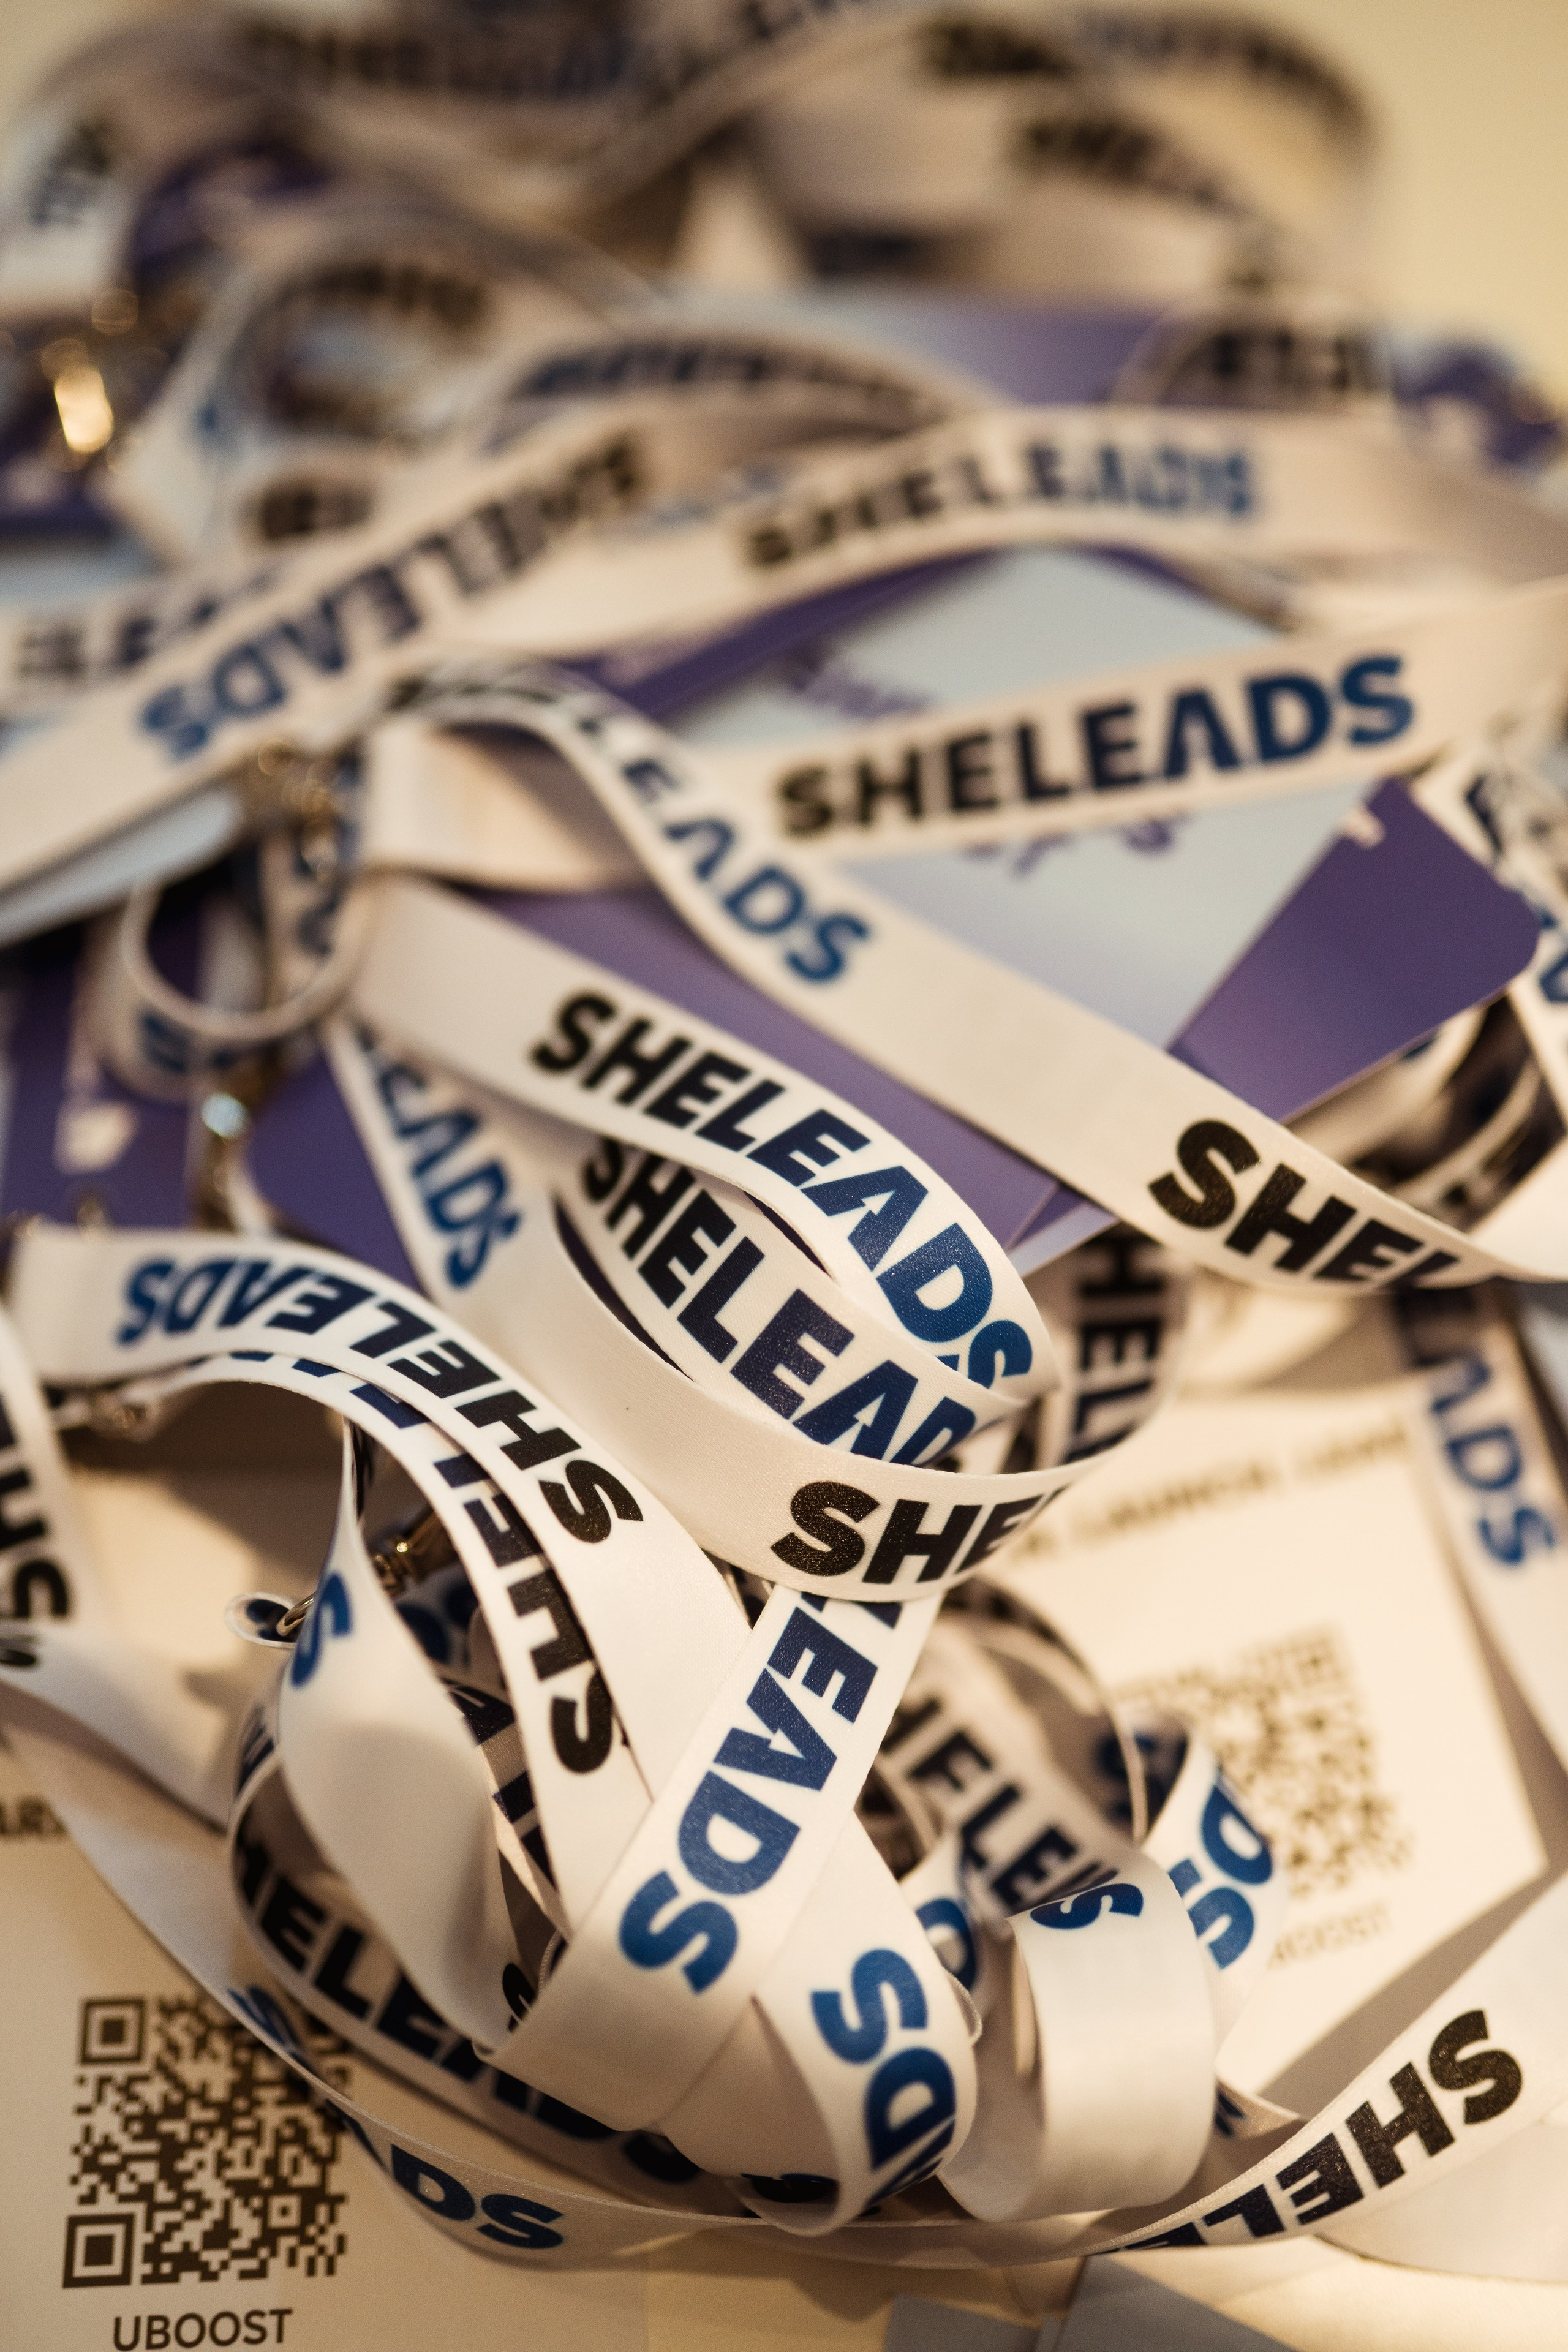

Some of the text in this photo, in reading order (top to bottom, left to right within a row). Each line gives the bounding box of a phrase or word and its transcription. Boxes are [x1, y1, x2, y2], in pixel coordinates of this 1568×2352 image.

[775, 654, 1416, 839] SHELEADS
[529, 990, 1035, 1390] SHELEADS
[116, 1253, 644, 1545] SHELEADS
[113, 2307, 293, 2351] UBOOST
